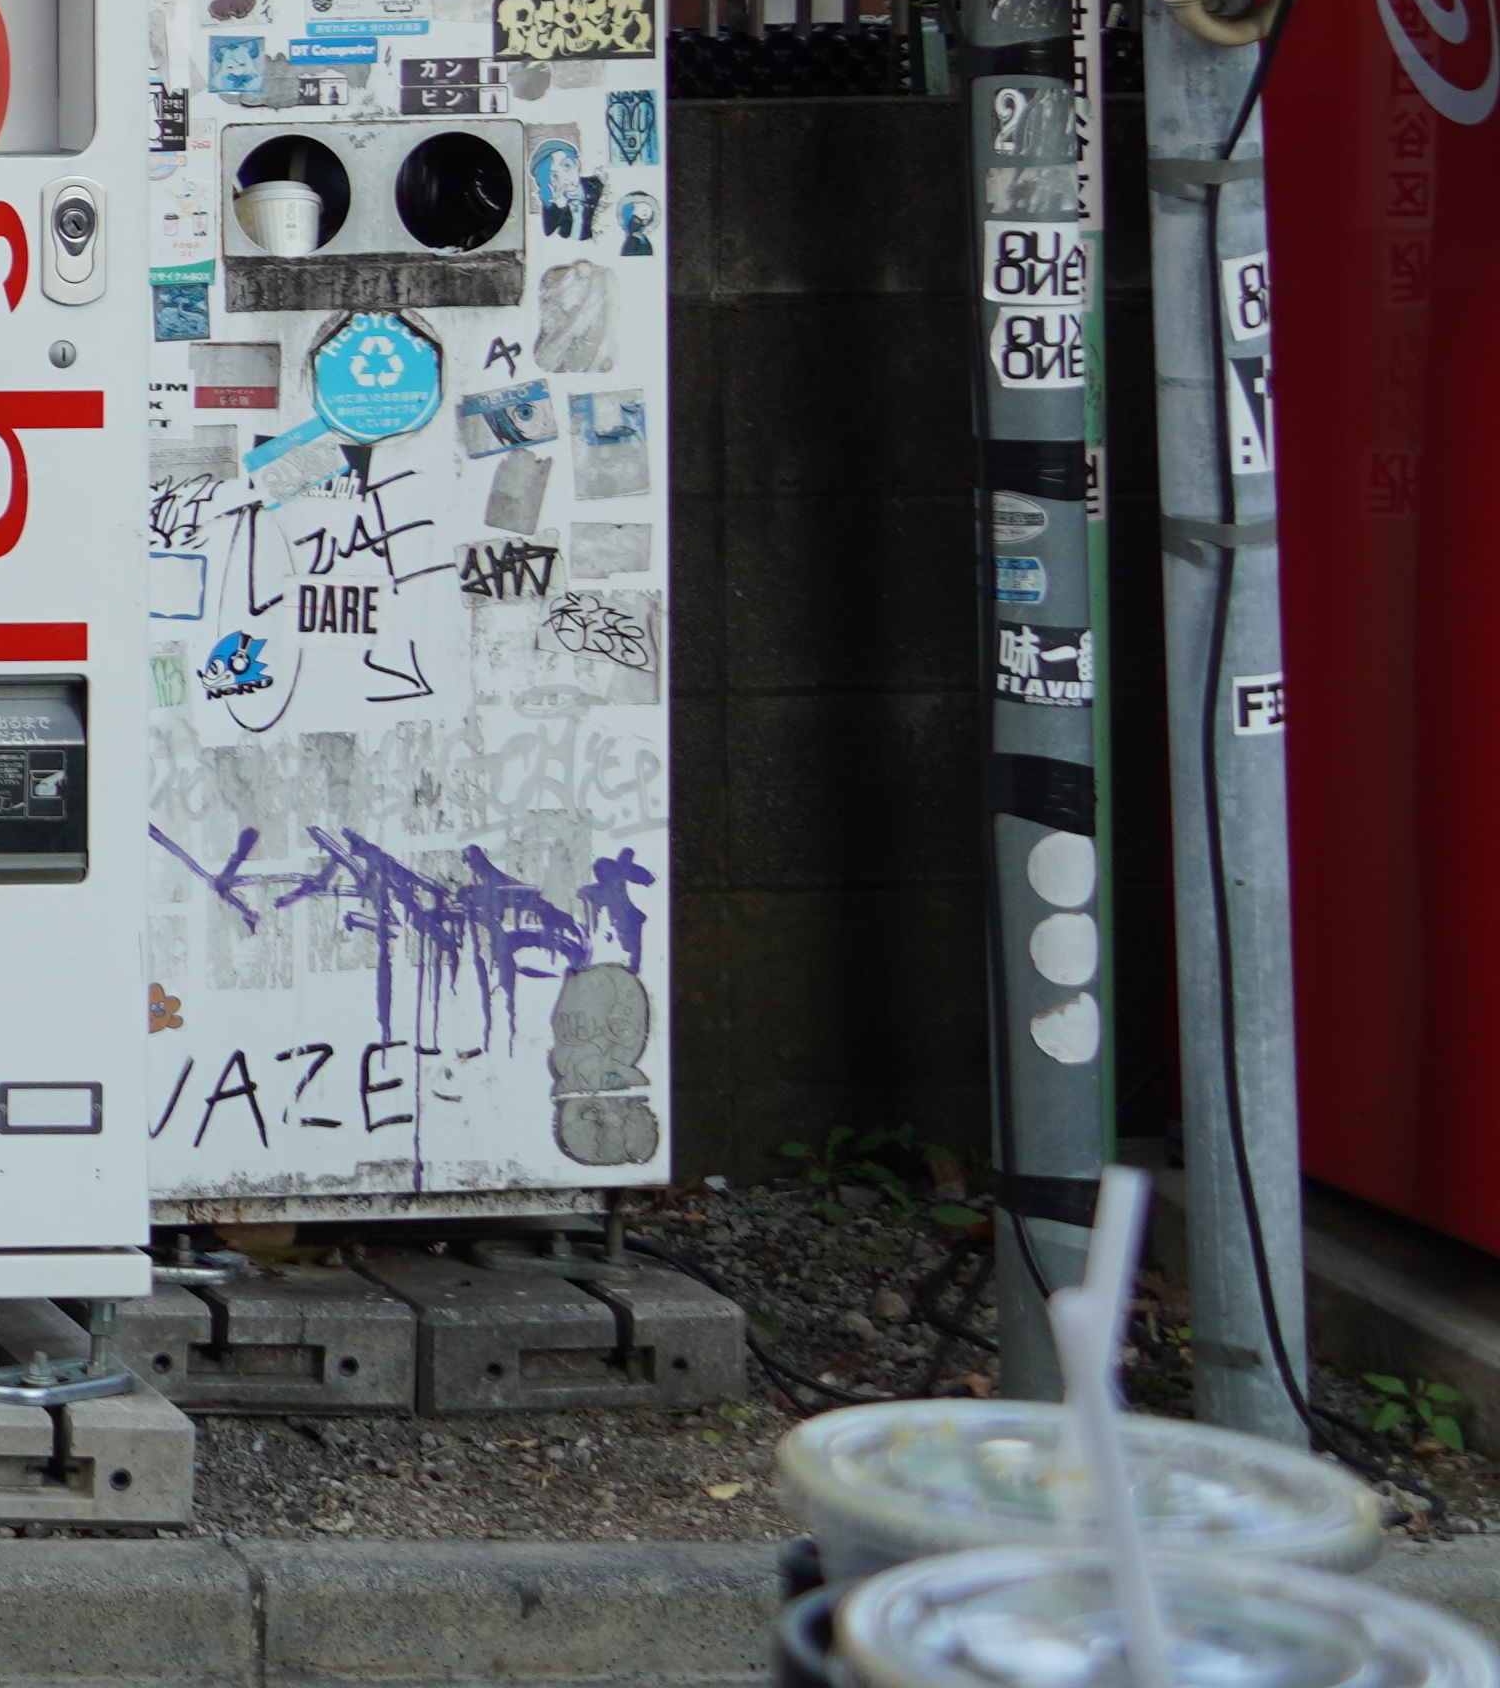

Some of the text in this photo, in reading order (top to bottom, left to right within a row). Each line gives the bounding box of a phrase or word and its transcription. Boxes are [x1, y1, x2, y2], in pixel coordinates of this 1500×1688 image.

[315, 42, 377, 60] Computer
[419, 61, 463, 80] カン
[420, 88, 464, 106] ビン
[298, 584, 379, 635] DARE
